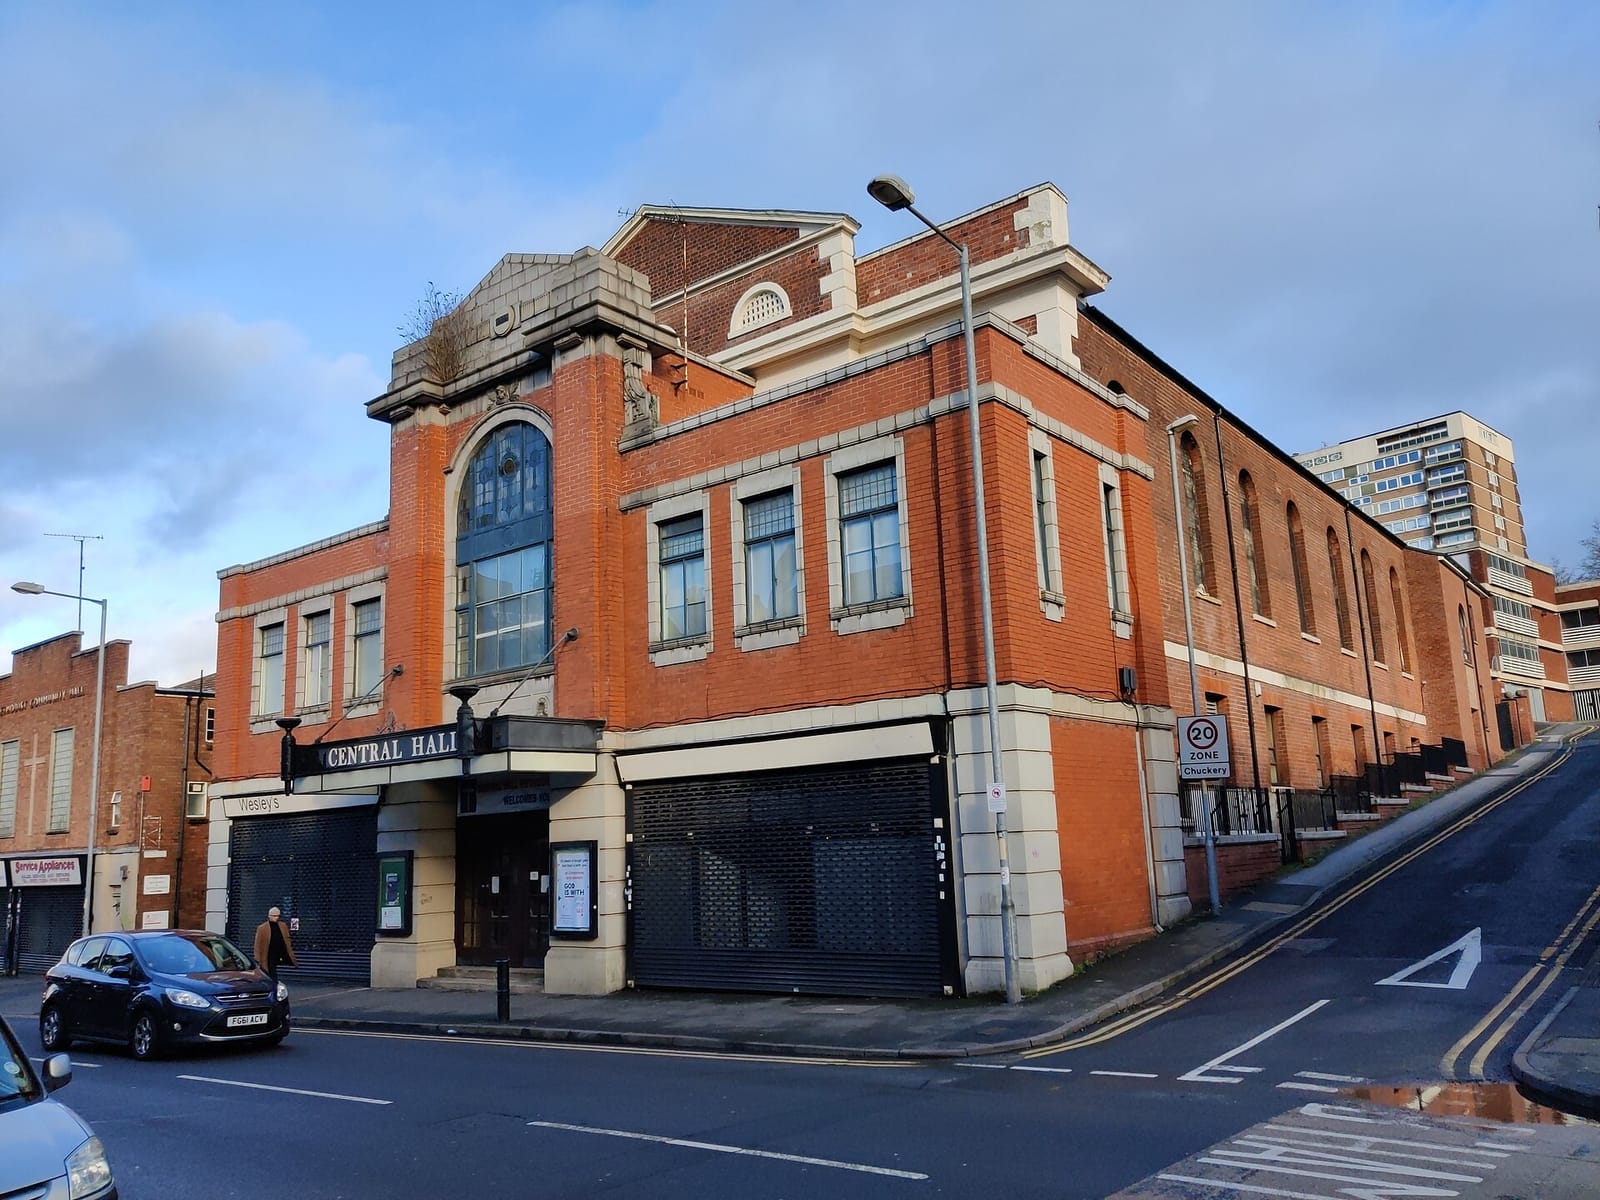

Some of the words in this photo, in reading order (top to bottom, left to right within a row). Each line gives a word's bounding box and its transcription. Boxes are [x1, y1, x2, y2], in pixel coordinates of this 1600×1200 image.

[1191, 726, 1214, 740] 20
[328, 739, 402, 766] CENTRAL
[1190, 751, 1219, 760] ZONE
[1184, 767, 1227, 775] Chuckery
[239, 797, 280, 812] Wesley's
[15, 861, 37, 873] Service
[39, 860, 74, 873] Appliances
